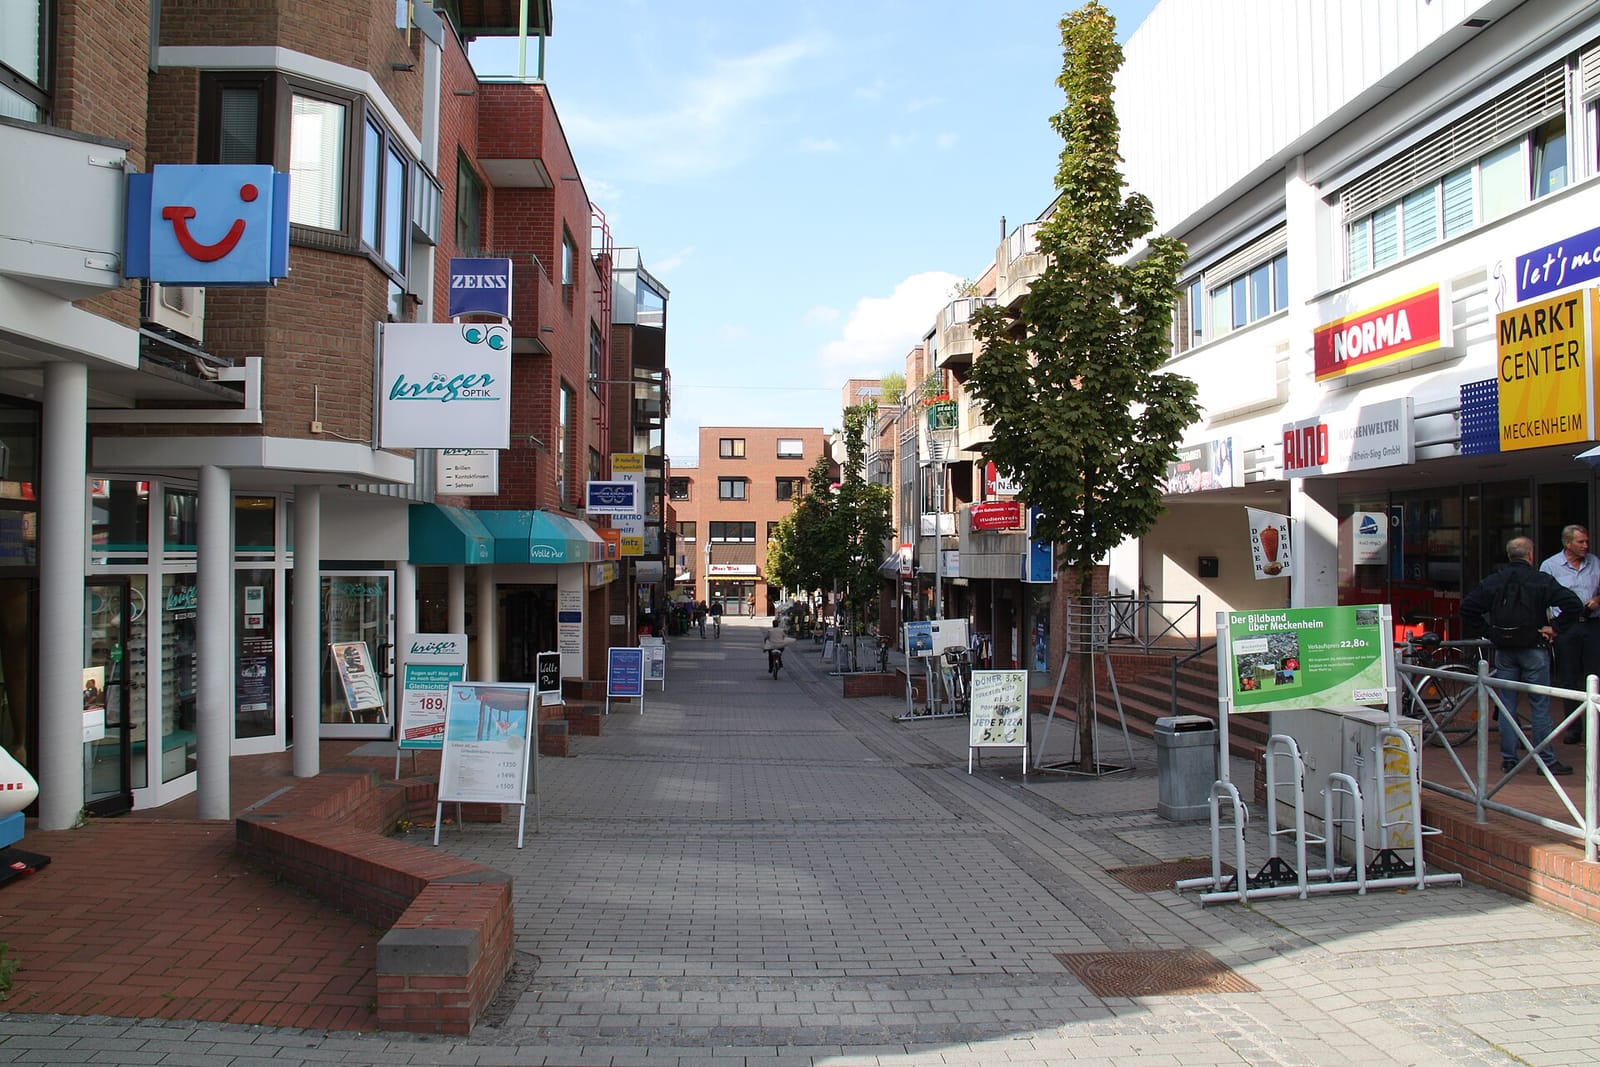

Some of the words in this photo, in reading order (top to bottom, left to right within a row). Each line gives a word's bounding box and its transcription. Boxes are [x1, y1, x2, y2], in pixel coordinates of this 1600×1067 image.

[1522, 246, 1567, 290] let's
[452, 274, 507, 289] ZEISS
[1501, 299, 1577, 346] MARKT
[1334, 309, 1412, 363] NORMA
[1501, 340, 1580, 383] CENTER
[389, 372, 496, 402] krüger
[462, 389, 490, 397] OPTIK
[1503, 413, 1582, 440] MECKENHEIM
[1283, 424, 1329, 470] ALNO
[1383, 445, 1401, 457] GmbH
[1251, 528, 1263, 571] DÖNER
[1279, 525, 1290, 568] KEBAB
[1230, 615, 1246, 624] Der
[1248, 613, 1287, 623] Bildband
[1248, 622, 1268, 631] über
[1270, 619, 1324, 631] Meckenheim
[410, 641, 457, 655] krüger
[1340, 638, 1365, 648] 22,80
[540, 662, 558, 673] Wolle
[973, 718, 996, 727] JEDE
[998, 718, 1023, 727] PIZZA
